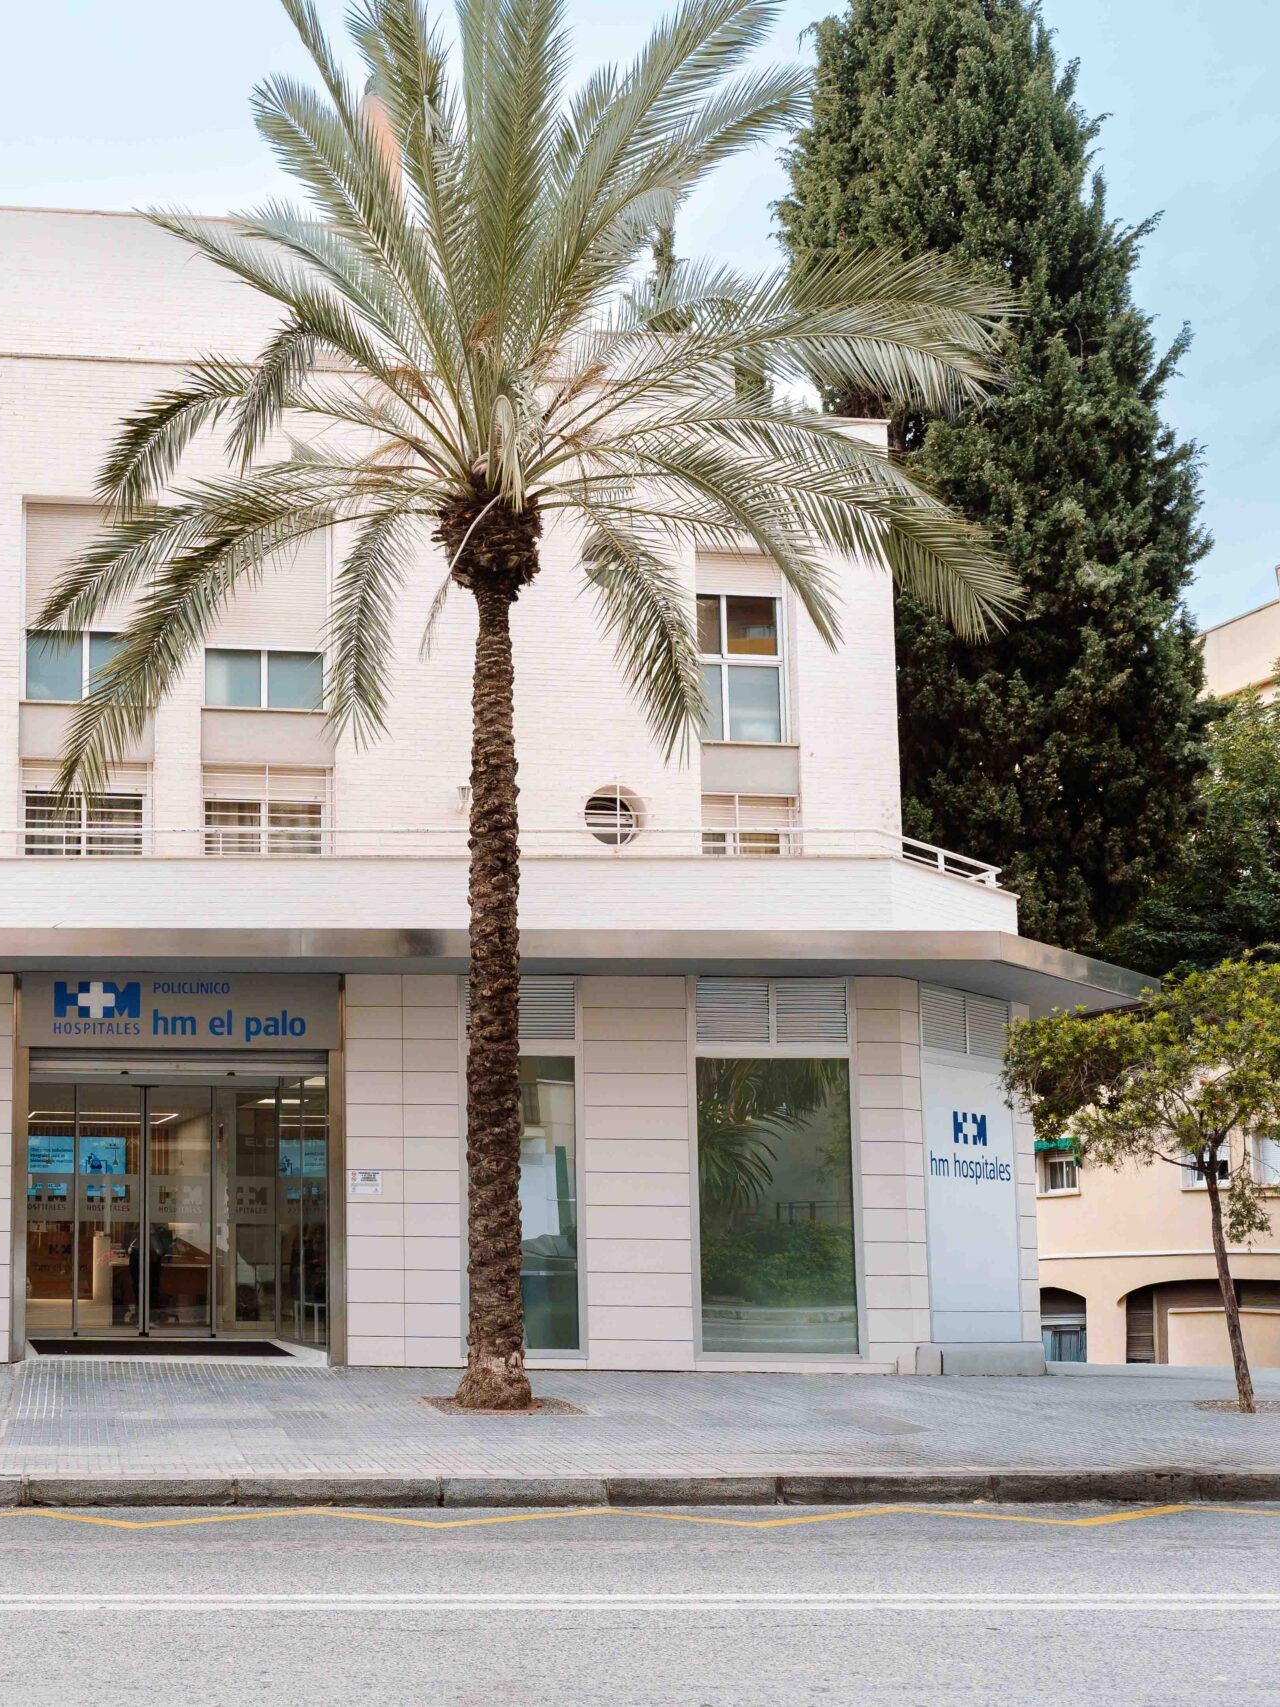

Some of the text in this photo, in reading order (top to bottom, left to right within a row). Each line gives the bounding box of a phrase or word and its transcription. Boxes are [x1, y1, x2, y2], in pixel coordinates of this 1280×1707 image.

[53, 1022, 141, 1036] HOSPITALES
[152, 1009, 306, 1042] hm el palo
[930, 1150, 1011, 1185] hm hospitales
